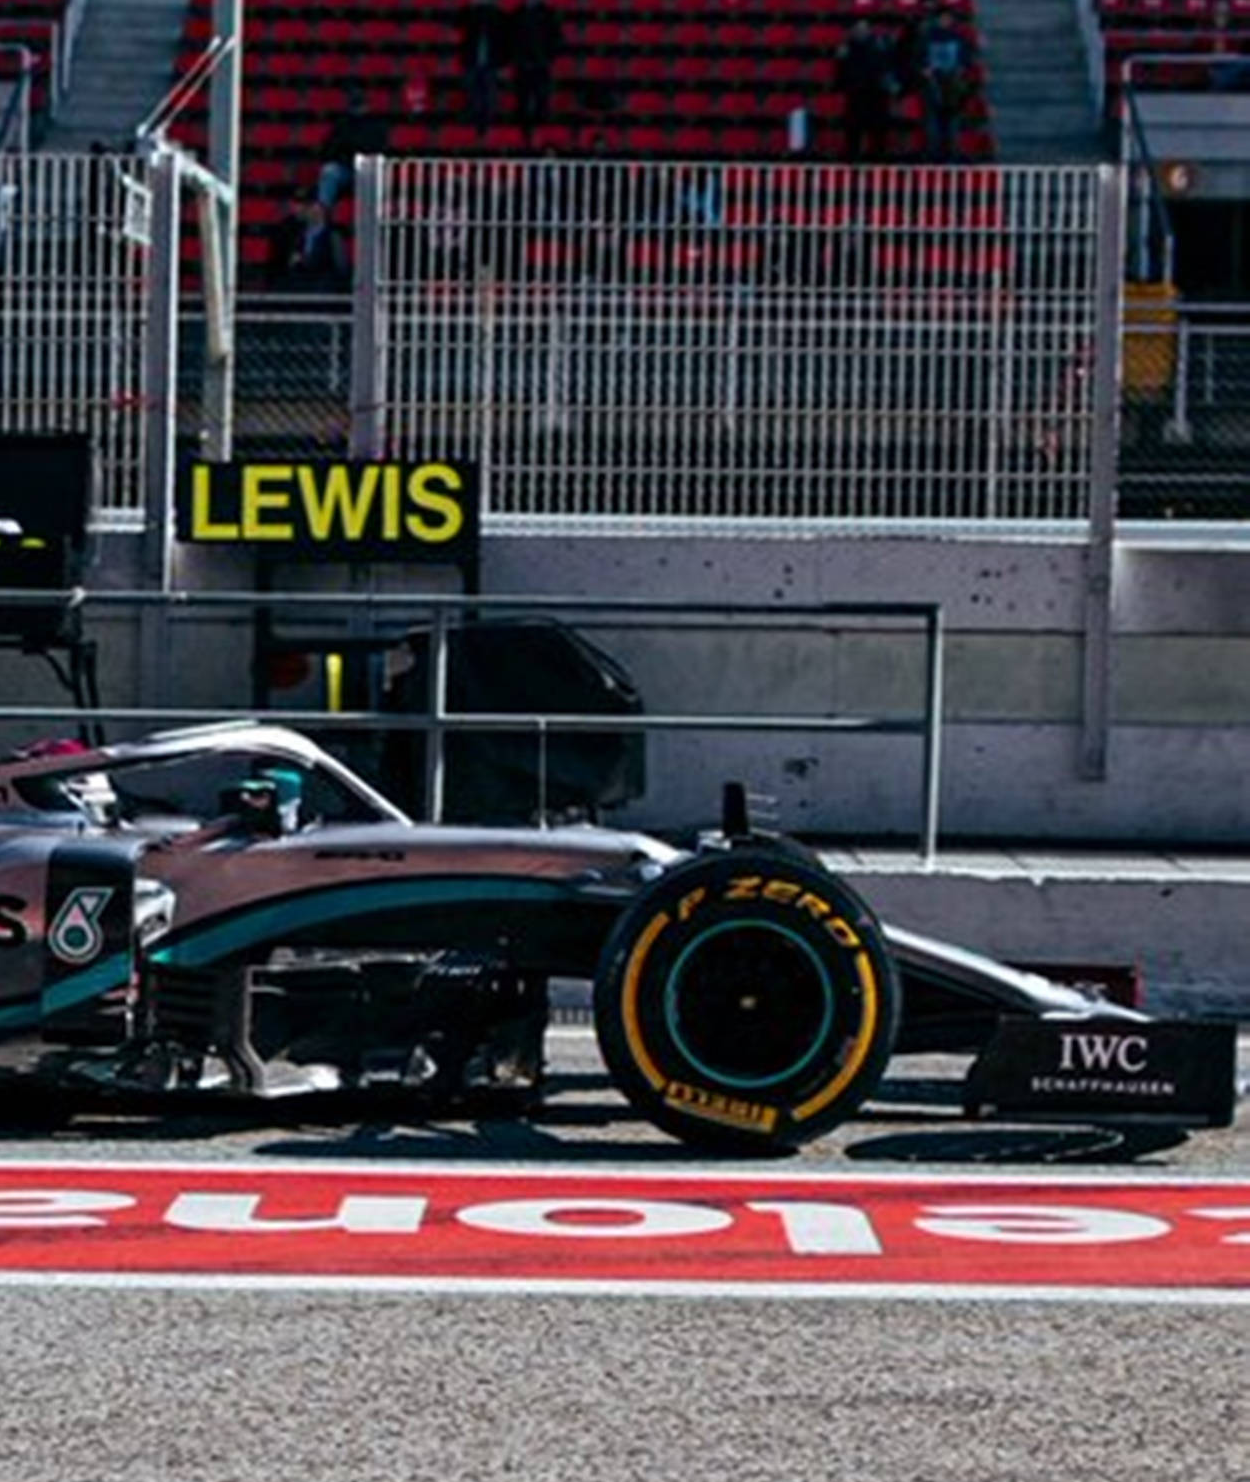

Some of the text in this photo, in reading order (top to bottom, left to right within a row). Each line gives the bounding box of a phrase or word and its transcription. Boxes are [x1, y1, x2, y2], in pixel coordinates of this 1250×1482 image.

[192, 464, 462, 542] LEWIS
[724, 876, 861, 948] ZERO
[1059, 1033, 1148, 1072] IWC
[1031, 1076, 1176, 1096] SCHAFFHAUSEN
